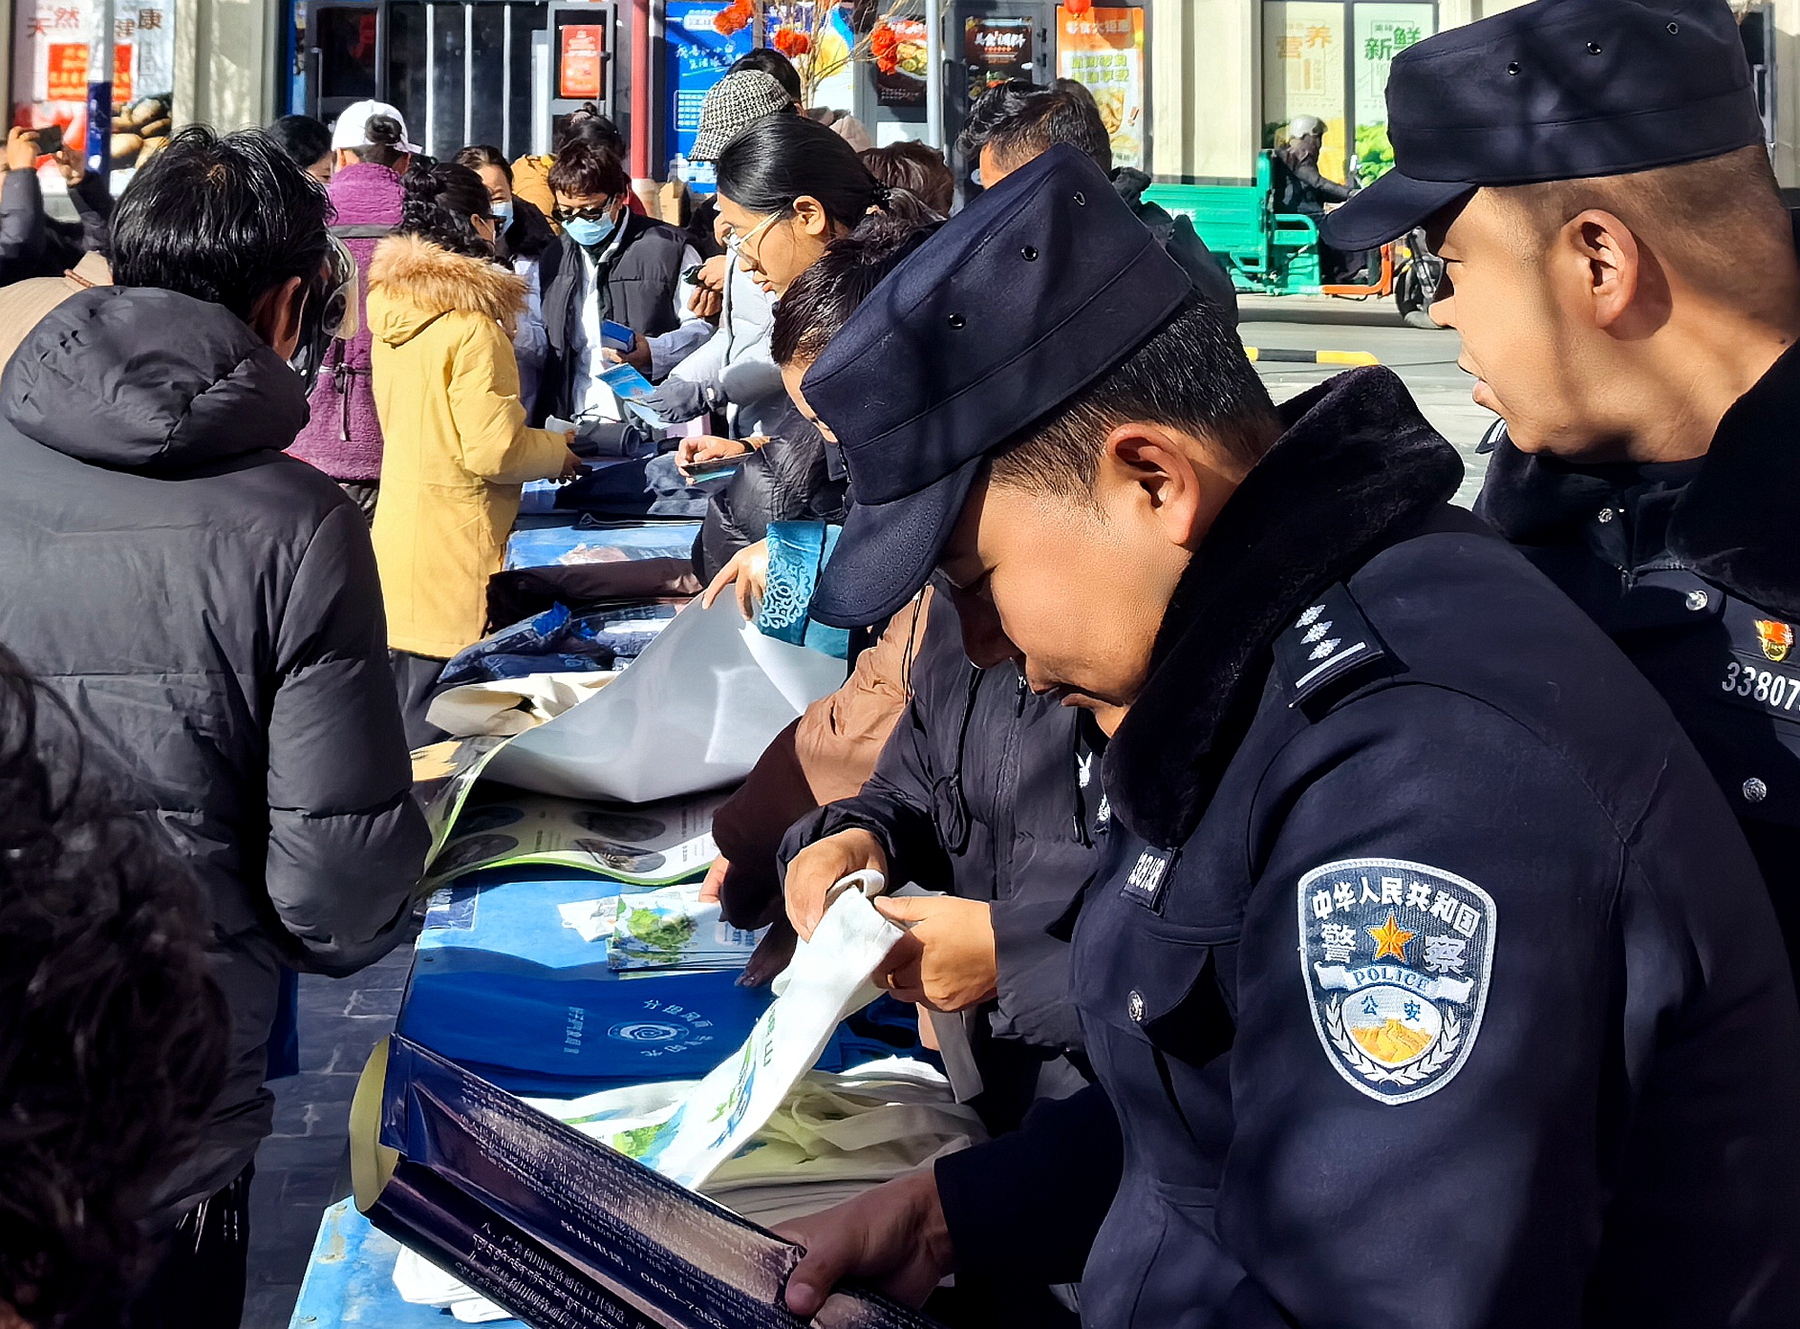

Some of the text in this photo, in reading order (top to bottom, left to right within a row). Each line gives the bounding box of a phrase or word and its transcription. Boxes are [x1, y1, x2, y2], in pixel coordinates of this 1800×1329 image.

[28, 8, 80, 37] 天然
[1275, 26, 1332, 60] 营养
[1365, 26, 1421, 61] 新鲜
[1722, 661, 1800, 711] 33807
[1312, 877, 1481, 938] 中华人民共和国
[1321, 923, 1467, 975] 警察
[1353, 967, 1430, 990] POLICE
[1361, 995, 1421, 1022] 公安
